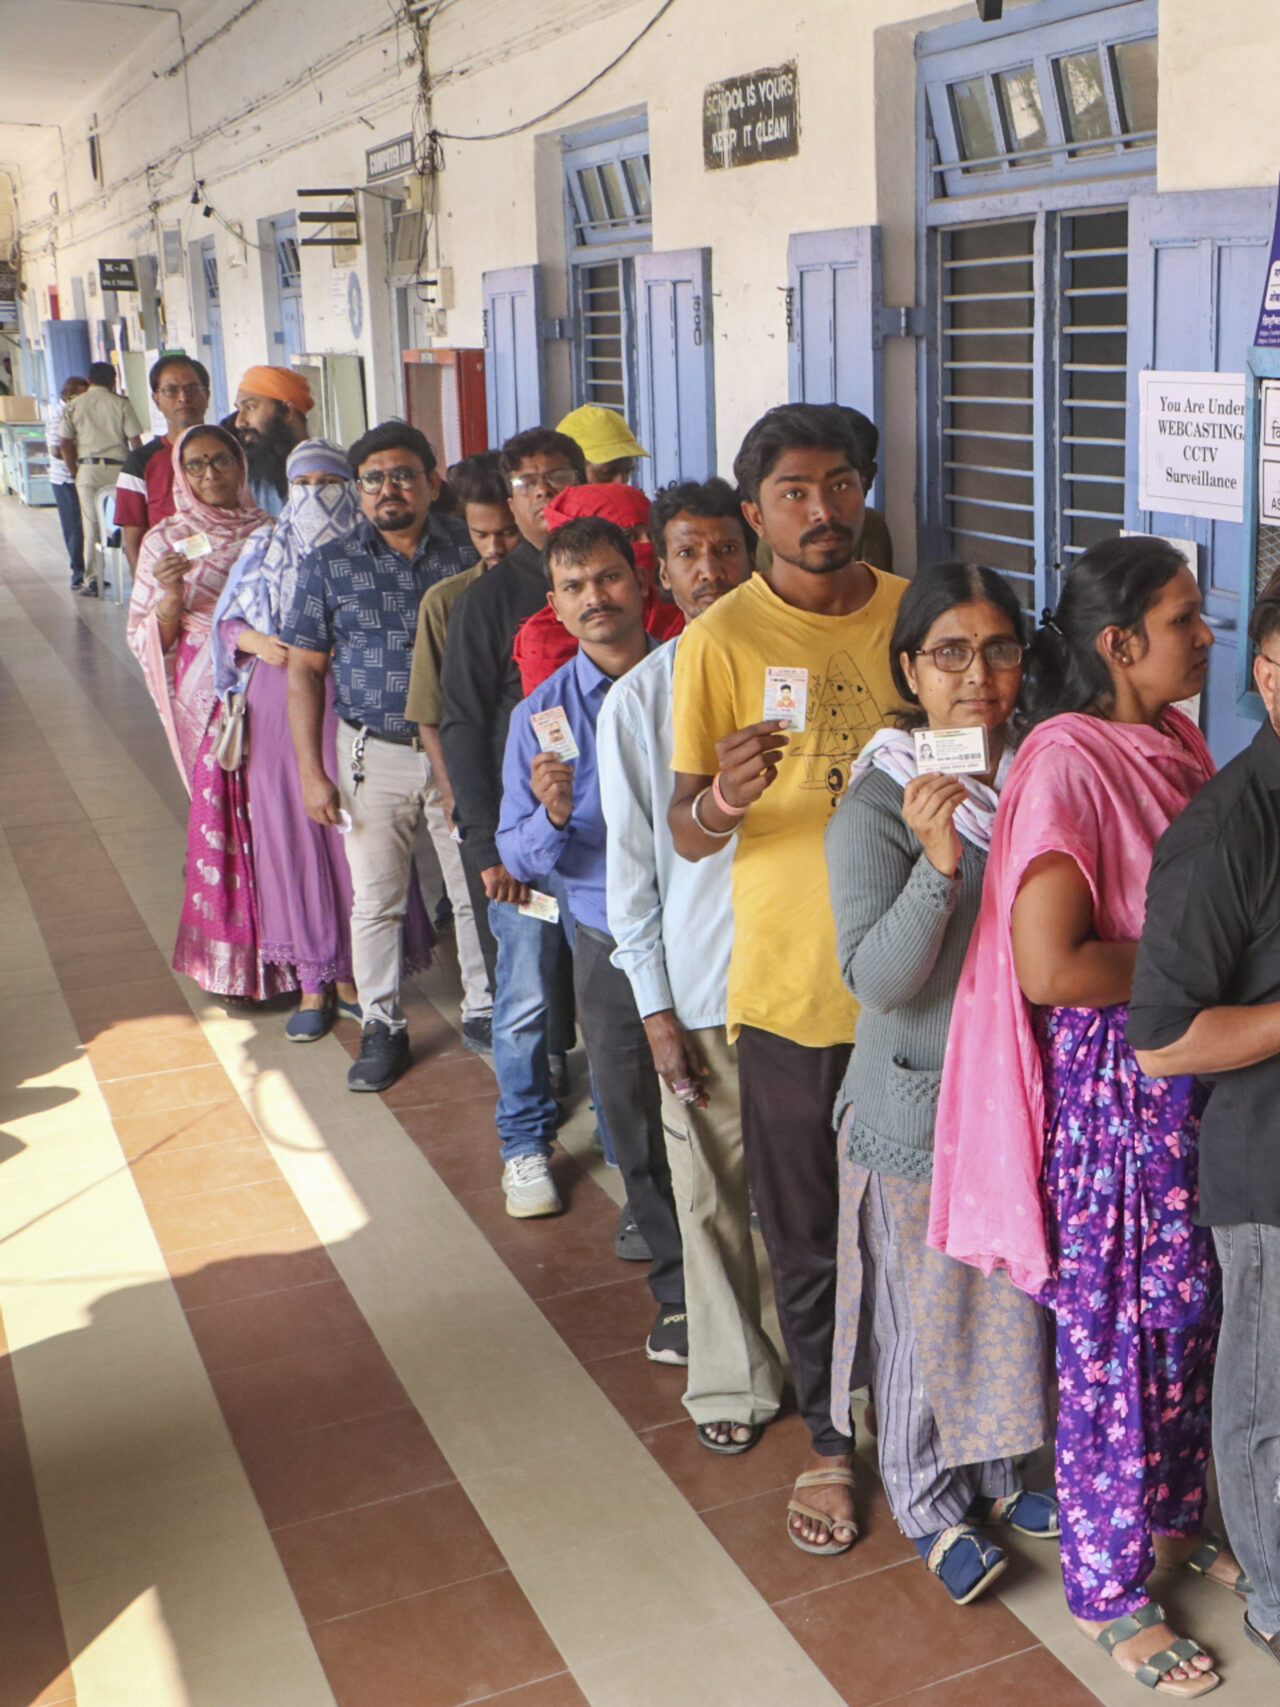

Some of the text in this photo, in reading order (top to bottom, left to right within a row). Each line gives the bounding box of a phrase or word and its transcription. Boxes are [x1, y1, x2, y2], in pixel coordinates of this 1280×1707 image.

[746, 84, 756, 106] IS
[758, 73, 793, 104] YOURS
[743, 124, 752, 147] IT
[756, 116, 788, 143] CLEAN
[1160, 396, 1245, 416] You Are Under
[1183, 445, 1218, 463] CCTV
[1166, 467, 1237, 489] Surveillance
